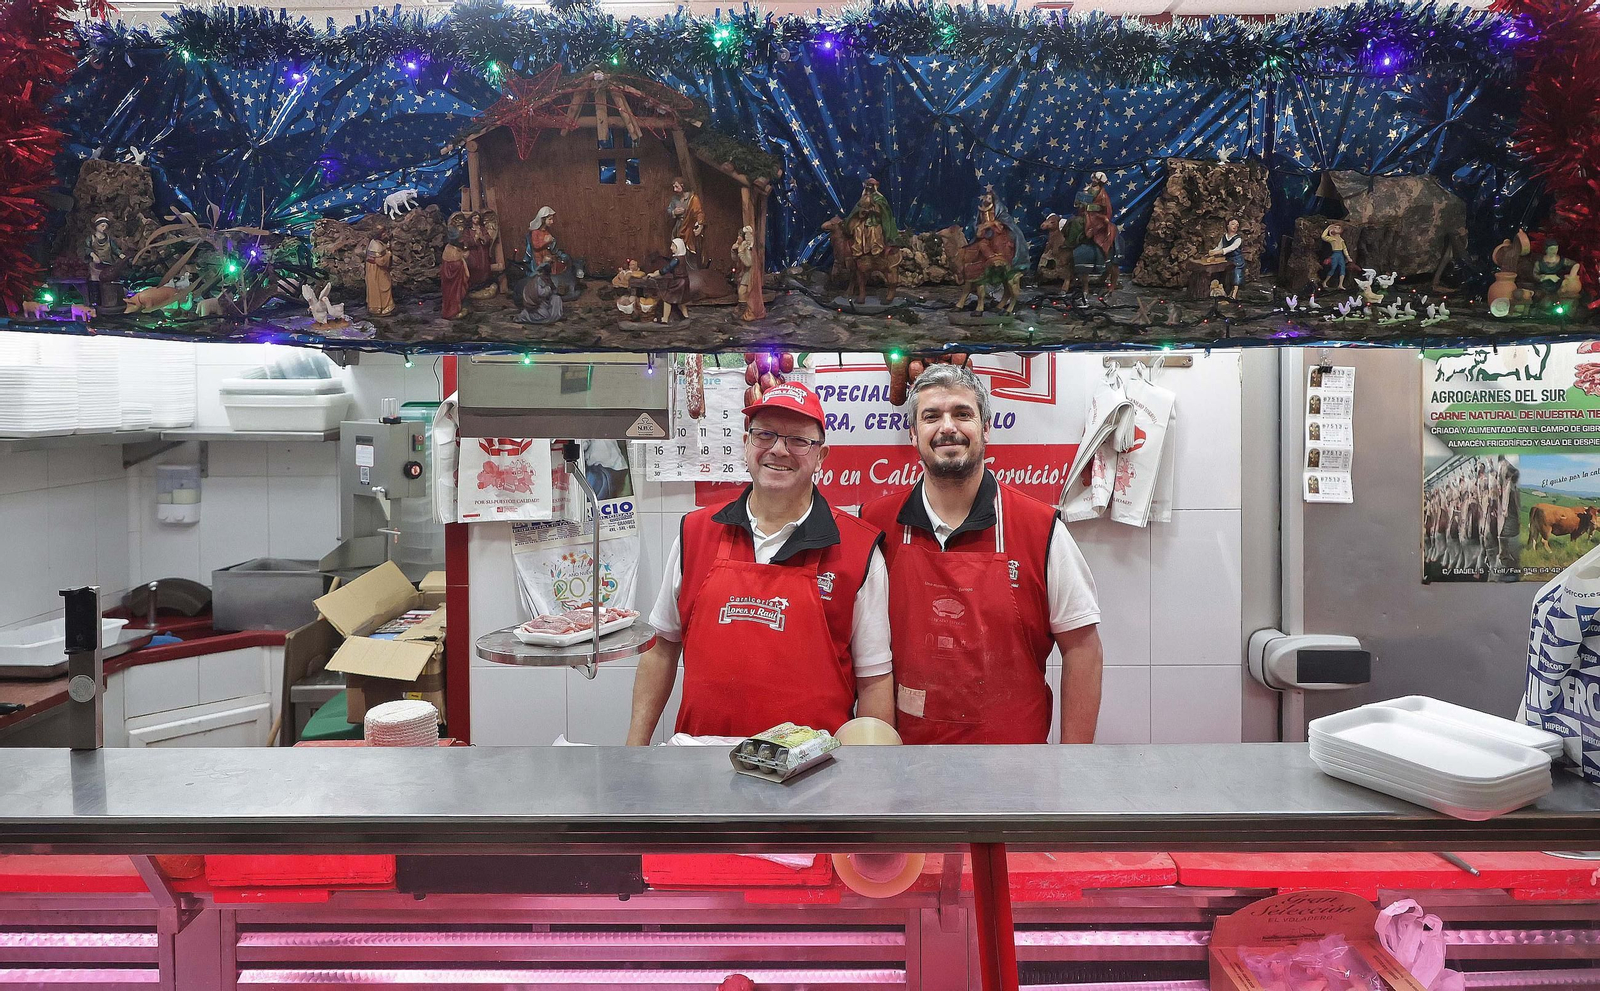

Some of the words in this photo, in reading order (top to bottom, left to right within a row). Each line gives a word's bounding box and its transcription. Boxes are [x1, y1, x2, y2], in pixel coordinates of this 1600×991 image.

[1431, 390, 1512, 403] AGROCARNES
[1515, 389, 1538, 402] DEL
[1541, 389, 1566, 402] SUR
[723, 410, 729, 419] 5
[1430, 411, 1466, 420] CARNE
[1469, 410, 1517, 420] NATURAL
[1519, 410, 1533, 419] DE
[1536, 410, 1584, 419] NUESTRA
[677, 428, 687, 437] 10
[700, 428, 707, 437] 11
[723, 428, 732, 437] 12
[1468, 426, 1516, 434] ALIMENTADA
[654, 446, 664, 455] 16
[677, 446, 686, 455] 17
[701, 446, 709, 455] 18
[723, 446, 732, 455] 19
[700, 463, 711, 473] 25
[723, 463, 734, 473] 26
[840, 470, 860, 486] en
[1569, 473, 1581, 482] por
[1281, 894, 1338, 904] Gran
[1250, 904, 1356, 917] Selección
[1283, 915, 1333, 923] VOLADERO
